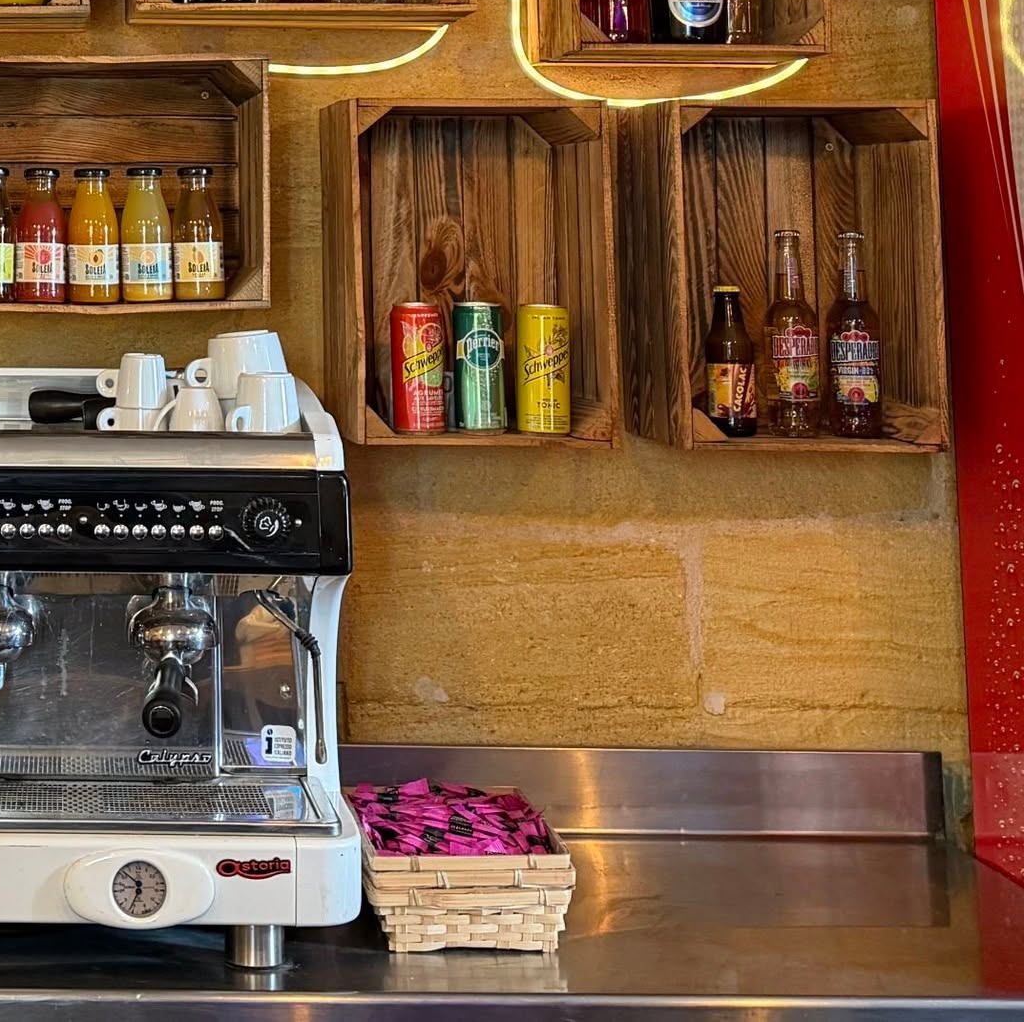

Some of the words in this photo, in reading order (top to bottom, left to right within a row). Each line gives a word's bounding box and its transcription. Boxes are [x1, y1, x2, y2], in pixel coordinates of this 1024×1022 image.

[466, 334, 499, 359] Perrier
[773, 337, 818, 357] DESPERAD
[831, 341, 880, 362] DESPERADO
[404, 349, 442, 379] Scwepp
[733, 367, 747, 412] CACOLAC
[138, 749, 212, 767] Calypso
